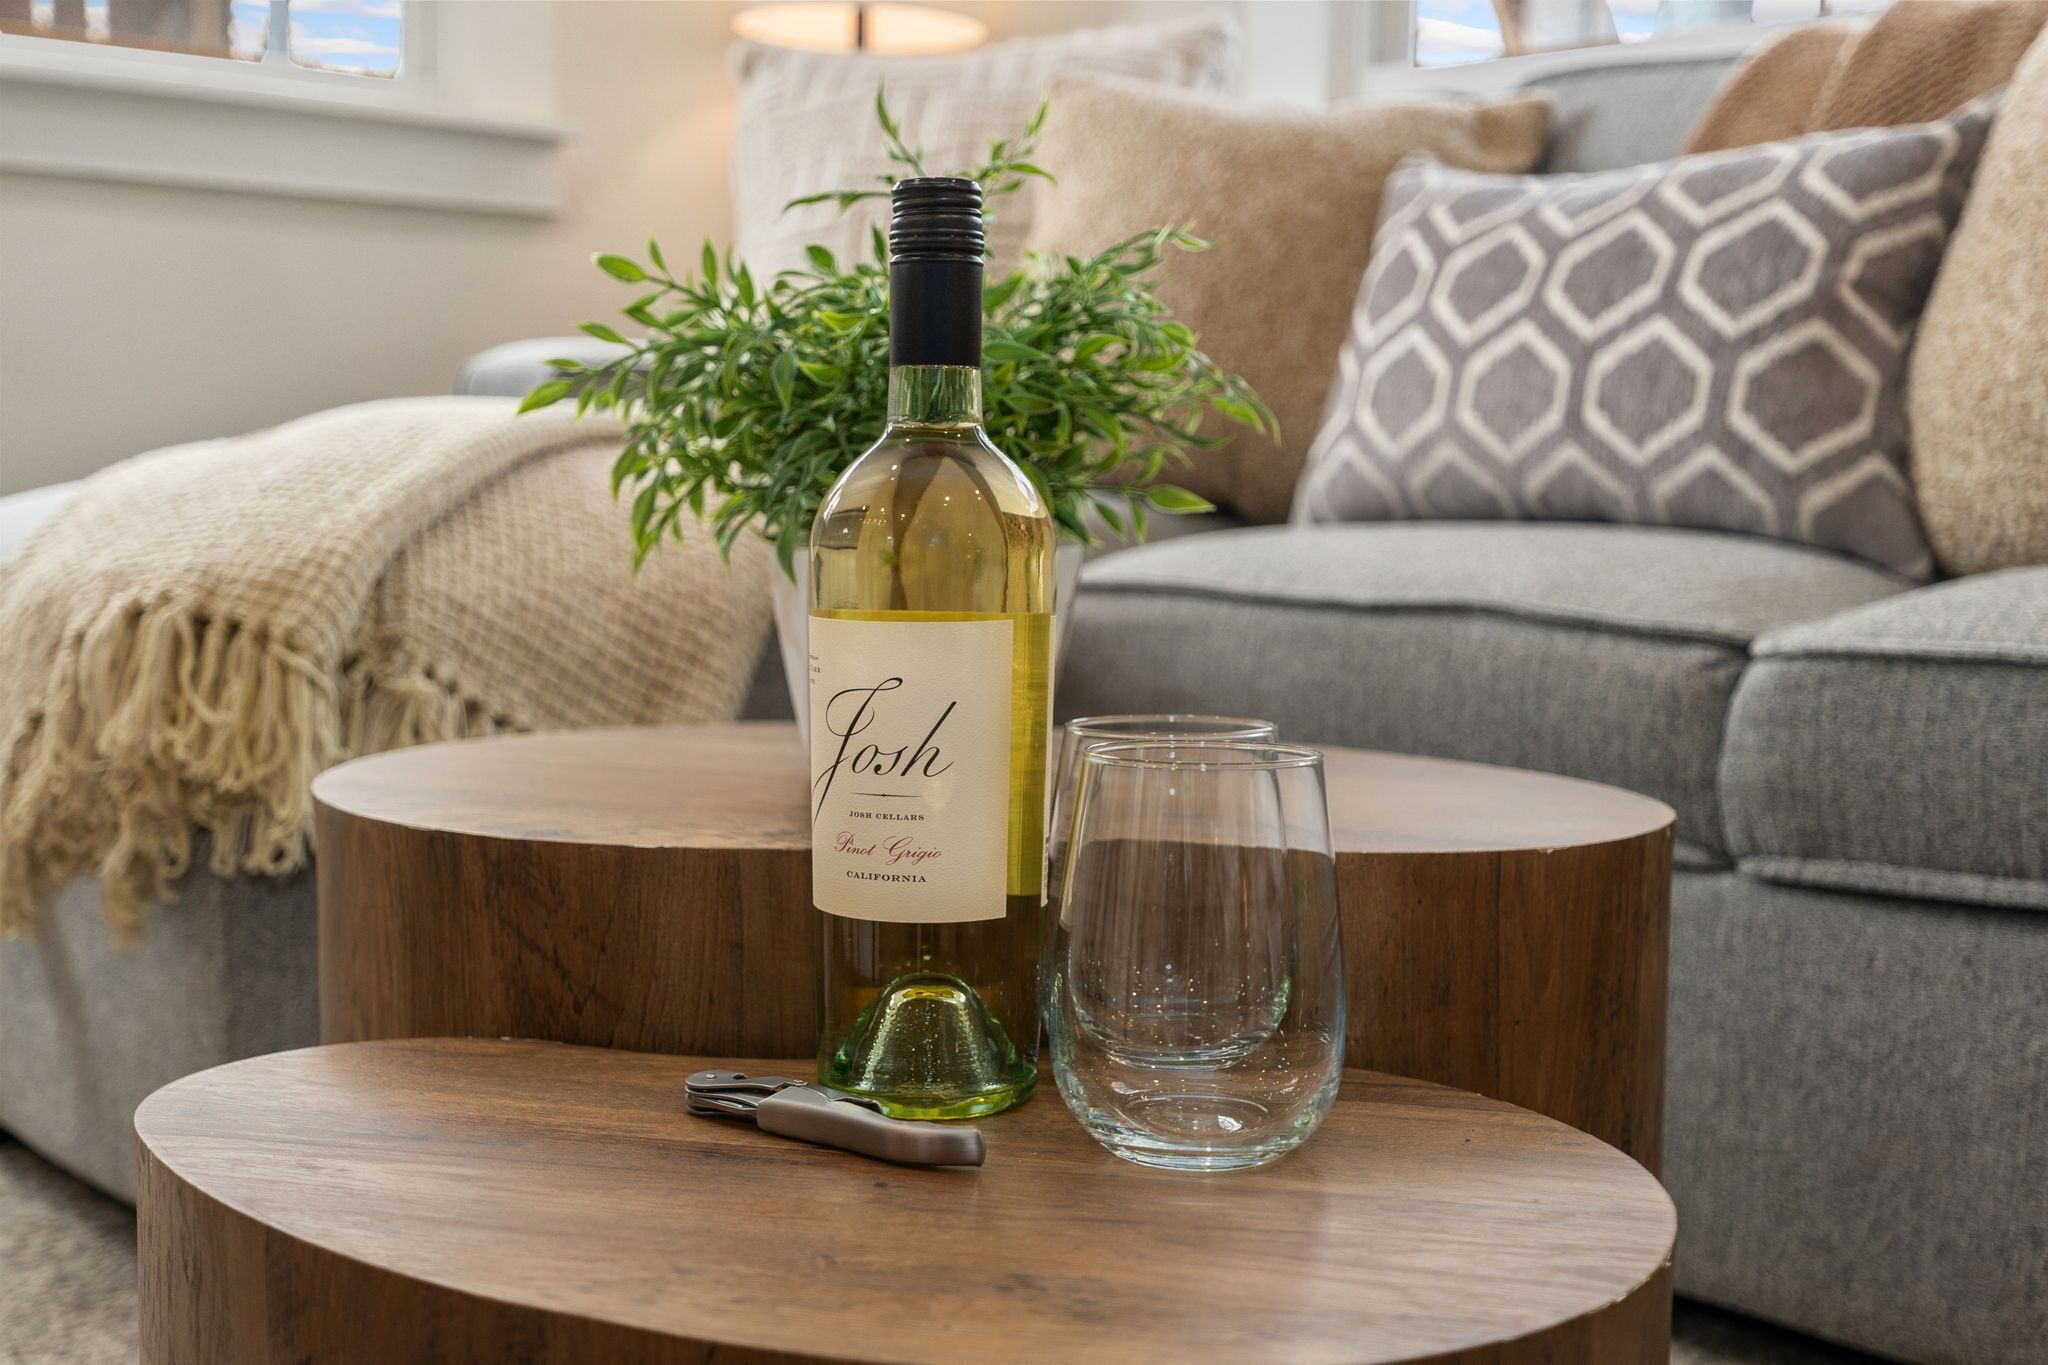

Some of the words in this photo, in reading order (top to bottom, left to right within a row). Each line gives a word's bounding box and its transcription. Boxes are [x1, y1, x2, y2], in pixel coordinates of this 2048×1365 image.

[813, 677, 957, 830] Josh
[849, 811, 872, 819] JOSH
[875, 813, 925, 821] CELLARS
[834, 831, 877, 856] Pinot
[883, 836, 942, 866] Grigio
[846, 870, 927, 883] CALIFORNIA
